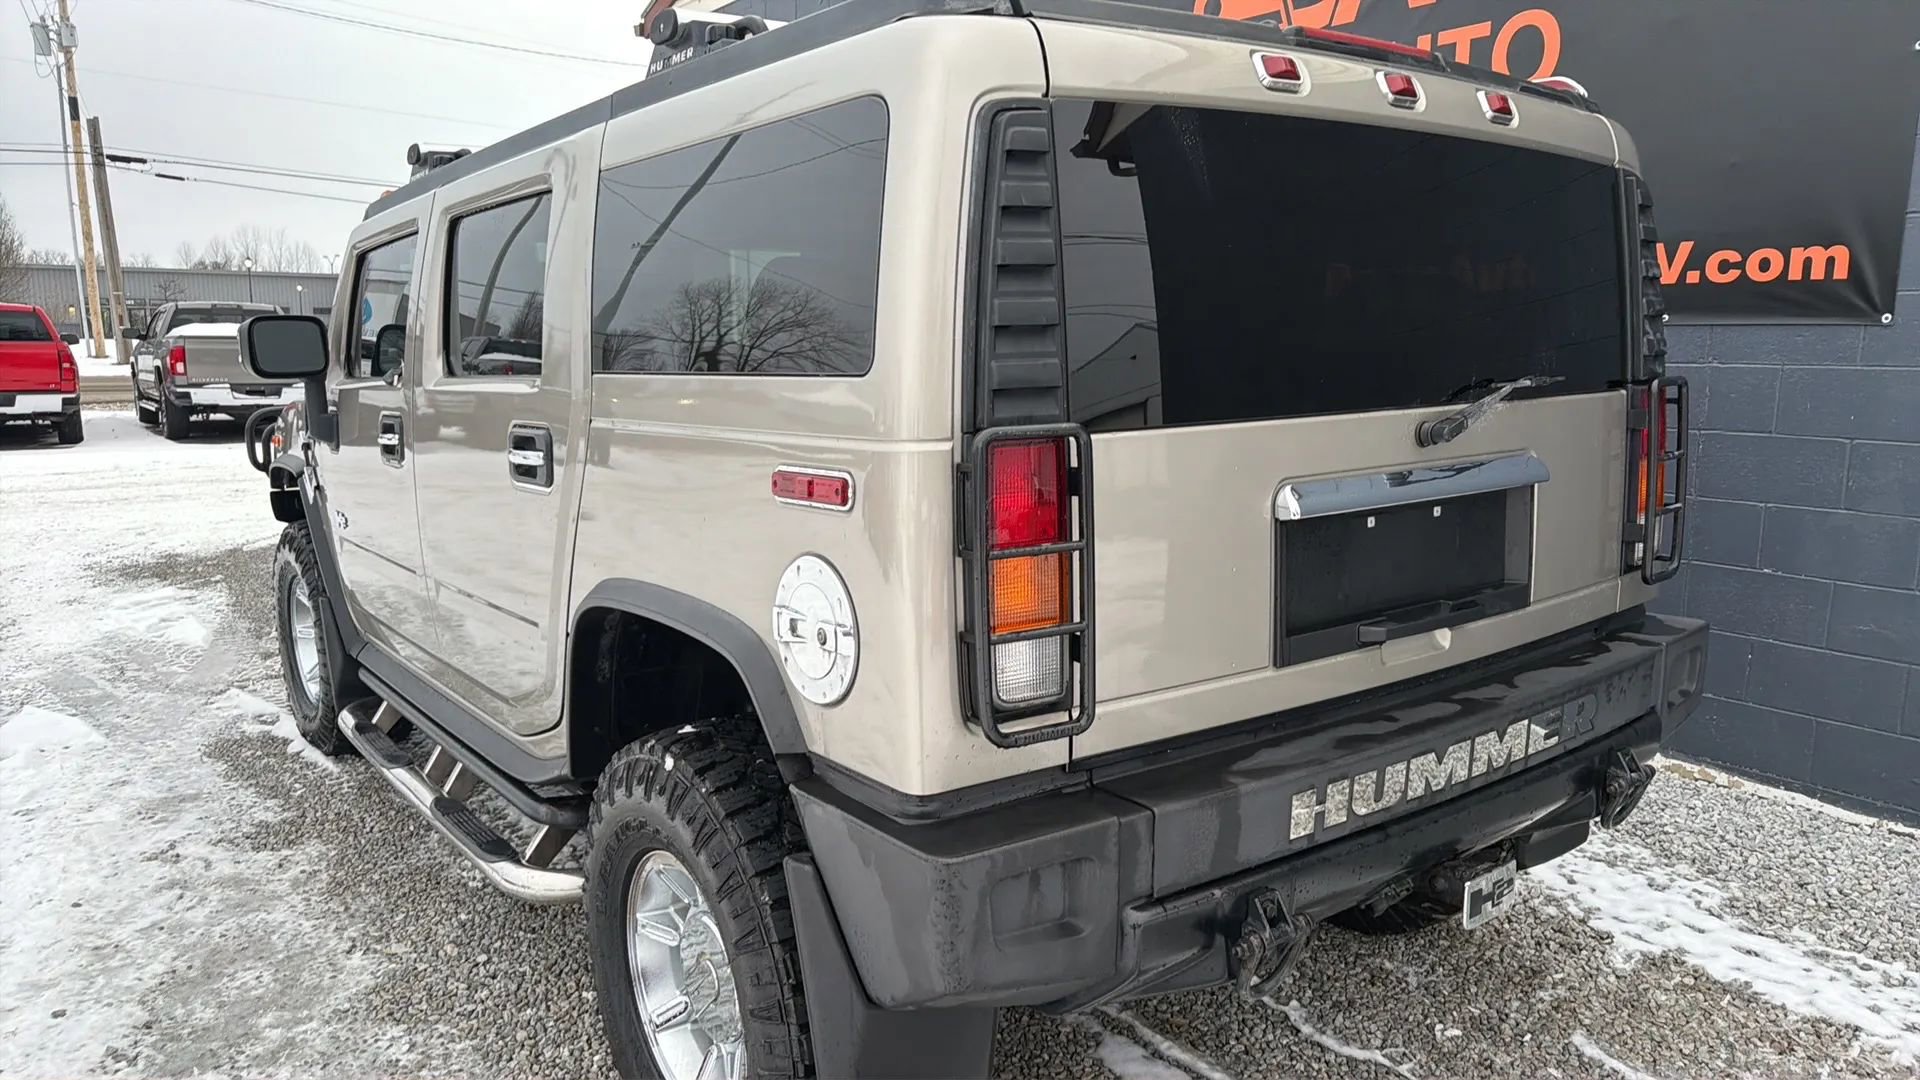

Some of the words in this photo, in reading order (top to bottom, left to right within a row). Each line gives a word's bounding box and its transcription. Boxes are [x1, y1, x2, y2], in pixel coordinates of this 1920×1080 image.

[650, 47, 694, 74] HUMMER
[1289, 694, 1598, 841] HUMMER
[1468, 877, 1514, 920] H2
